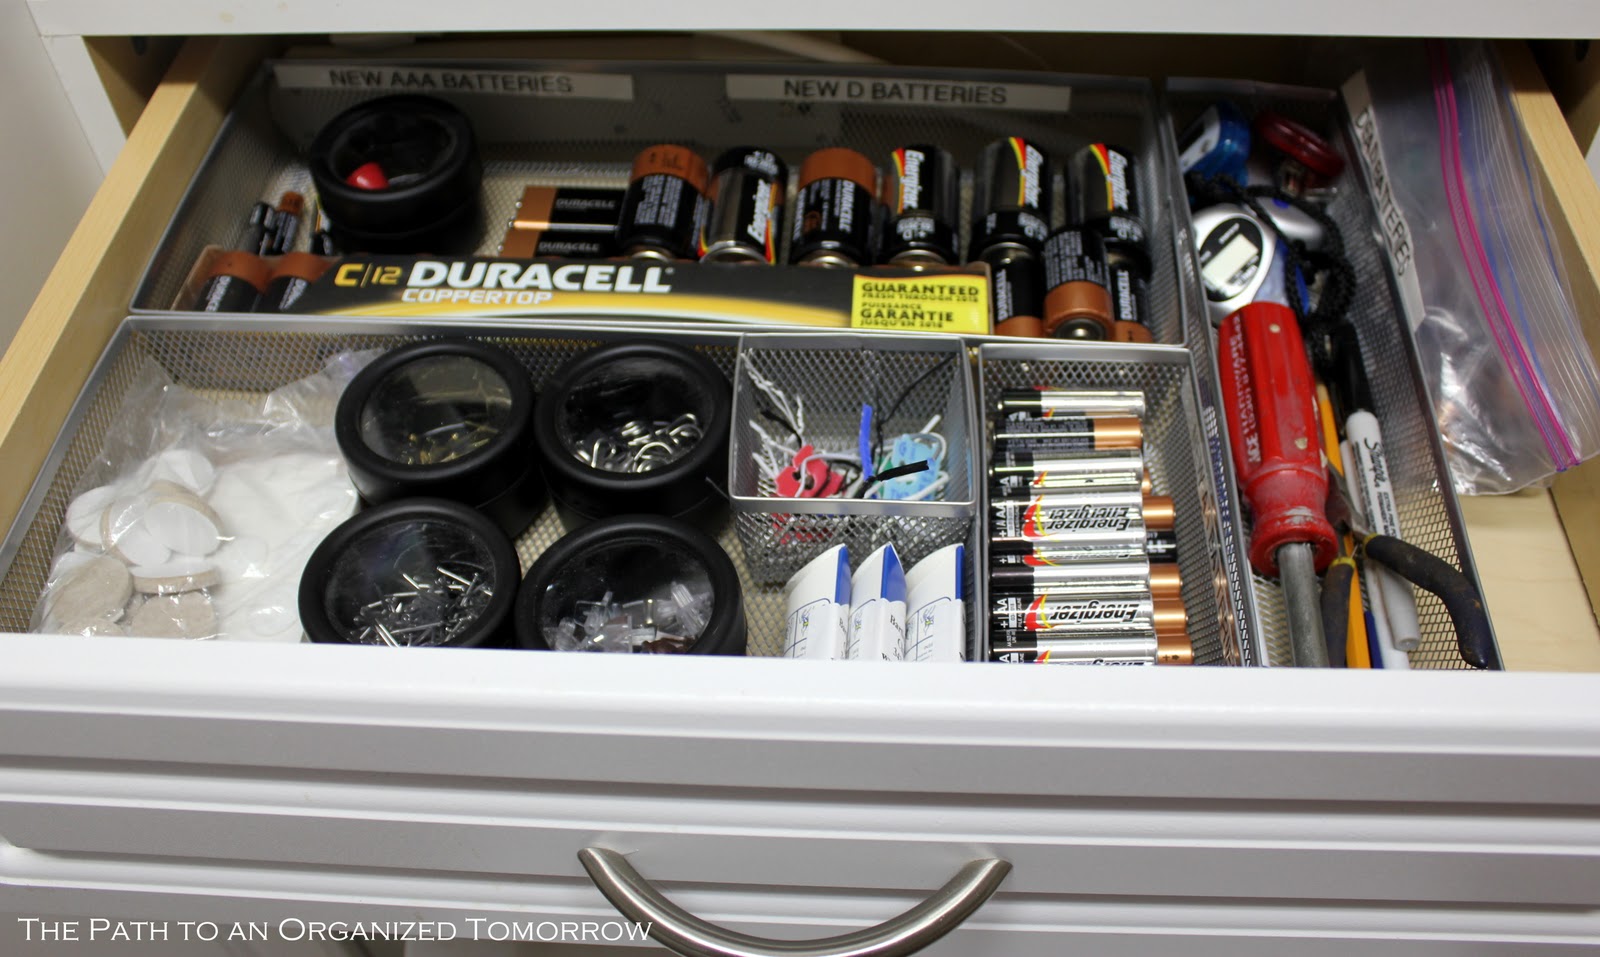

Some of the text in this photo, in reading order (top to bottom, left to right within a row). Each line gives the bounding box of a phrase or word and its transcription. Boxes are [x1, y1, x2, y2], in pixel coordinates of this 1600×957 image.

[329, 69, 574, 94] NEW AAA BATTERIES
[784, 79, 1008, 105] NEW D BATTERIES
[900, 149, 925, 210] Energizer
[556, 198, 616, 209] DURACELL
[838, 179, 855, 233] DURACELL
[1371, 158, 1411, 277] BATTERES
[538, 241, 600, 252] DURACELL
[406, 260, 672, 293] DURACELL
[401, 287, 554, 305] COPPERTOP
[861, 282, 980, 296] GUARANTEED
[1117, 269, 1133, 321] DURACELL
[860, 308, 953, 322] GARANTIE
[861, 301, 922, 310] PUISSANCE
[1050, 600, 1140, 623] Energizer
